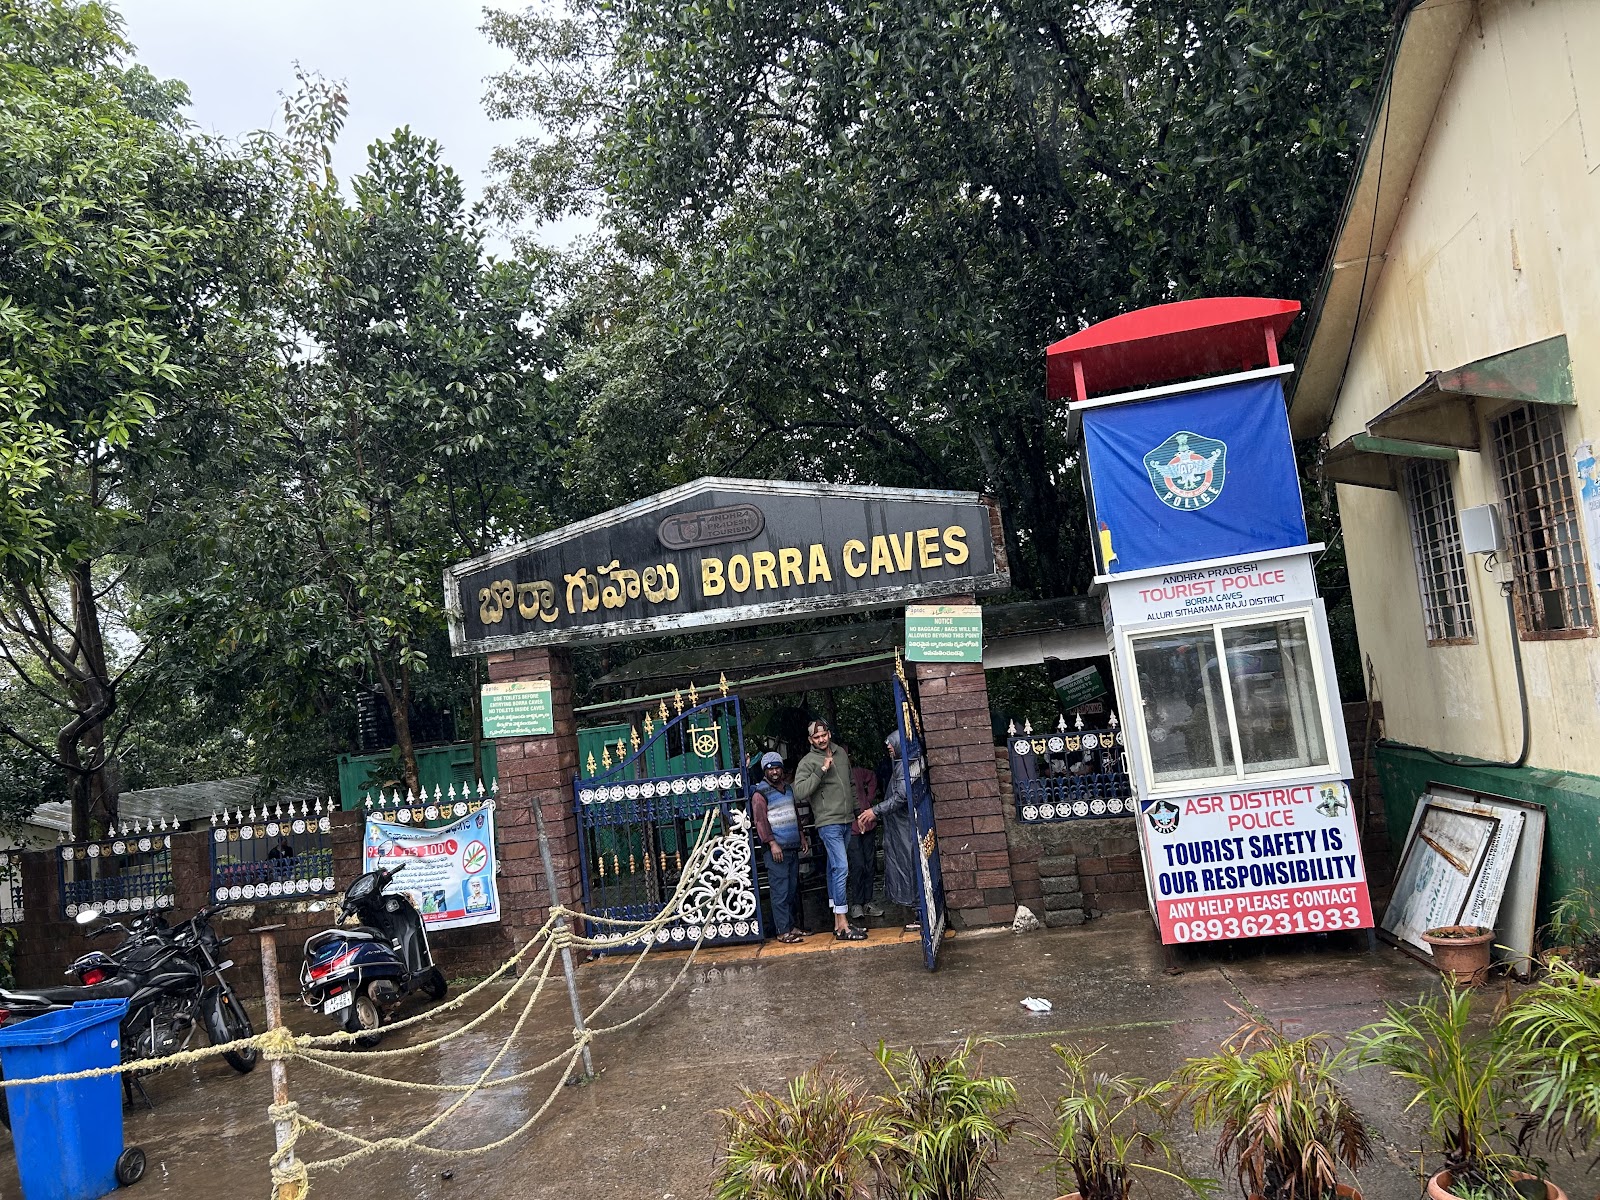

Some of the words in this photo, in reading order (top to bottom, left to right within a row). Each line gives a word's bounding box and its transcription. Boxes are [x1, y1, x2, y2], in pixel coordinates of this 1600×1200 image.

[1163, 486, 1219, 508] POLICE
[707, 519, 751, 530] PRADESH
[708, 510, 749, 522] ANDHRA
[708, 526, 751, 537] TOURISM
[701, 543, 833, 596] BORRA
[842, 525, 969, 578] CAVES
[1162, 571, 1205, 585] ANDHRA
[1208, 563, 1258, 578] PRADESH
[564, 559, 680, 614] గుహలు
[1139, 580, 1216, 603] TOURIST
[1222, 569, 1286, 591] POLICE
[1185, 596, 1214, 607] BORRA
[1216, 591, 1243, 602] CAVES
[1147, 610, 1174, 621] ALLURI
[1175, 603, 1223, 616] SITHARAMA
[1225, 600, 1247, 609] RAJU
[1250, 594, 1286, 605] DISTRICT
[1185, 796, 1225, 816] ASR
[1229, 786, 1315, 811] DISTRICT
[1227, 809, 1295, 832] POLICE
[423, 844, 445, 856] 100
[1163, 837, 1244, 867] TOURIST
[1249, 829, 1317, 859] SAFETY
[1321, 827, 1343, 852] IS
[1158, 870, 1199, 896] OUR
[1201, 854, 1356, 892] RESPONSIBILITY
[1169, 901, 1195, 920] ANY
[1199, 898, 1234, 917] HELP
[1236, 893, 1290, 914] PLEASE
[1293, 886, 1357, 909] CONTACT
[1173, 907, 1361, 943] 08936231933
